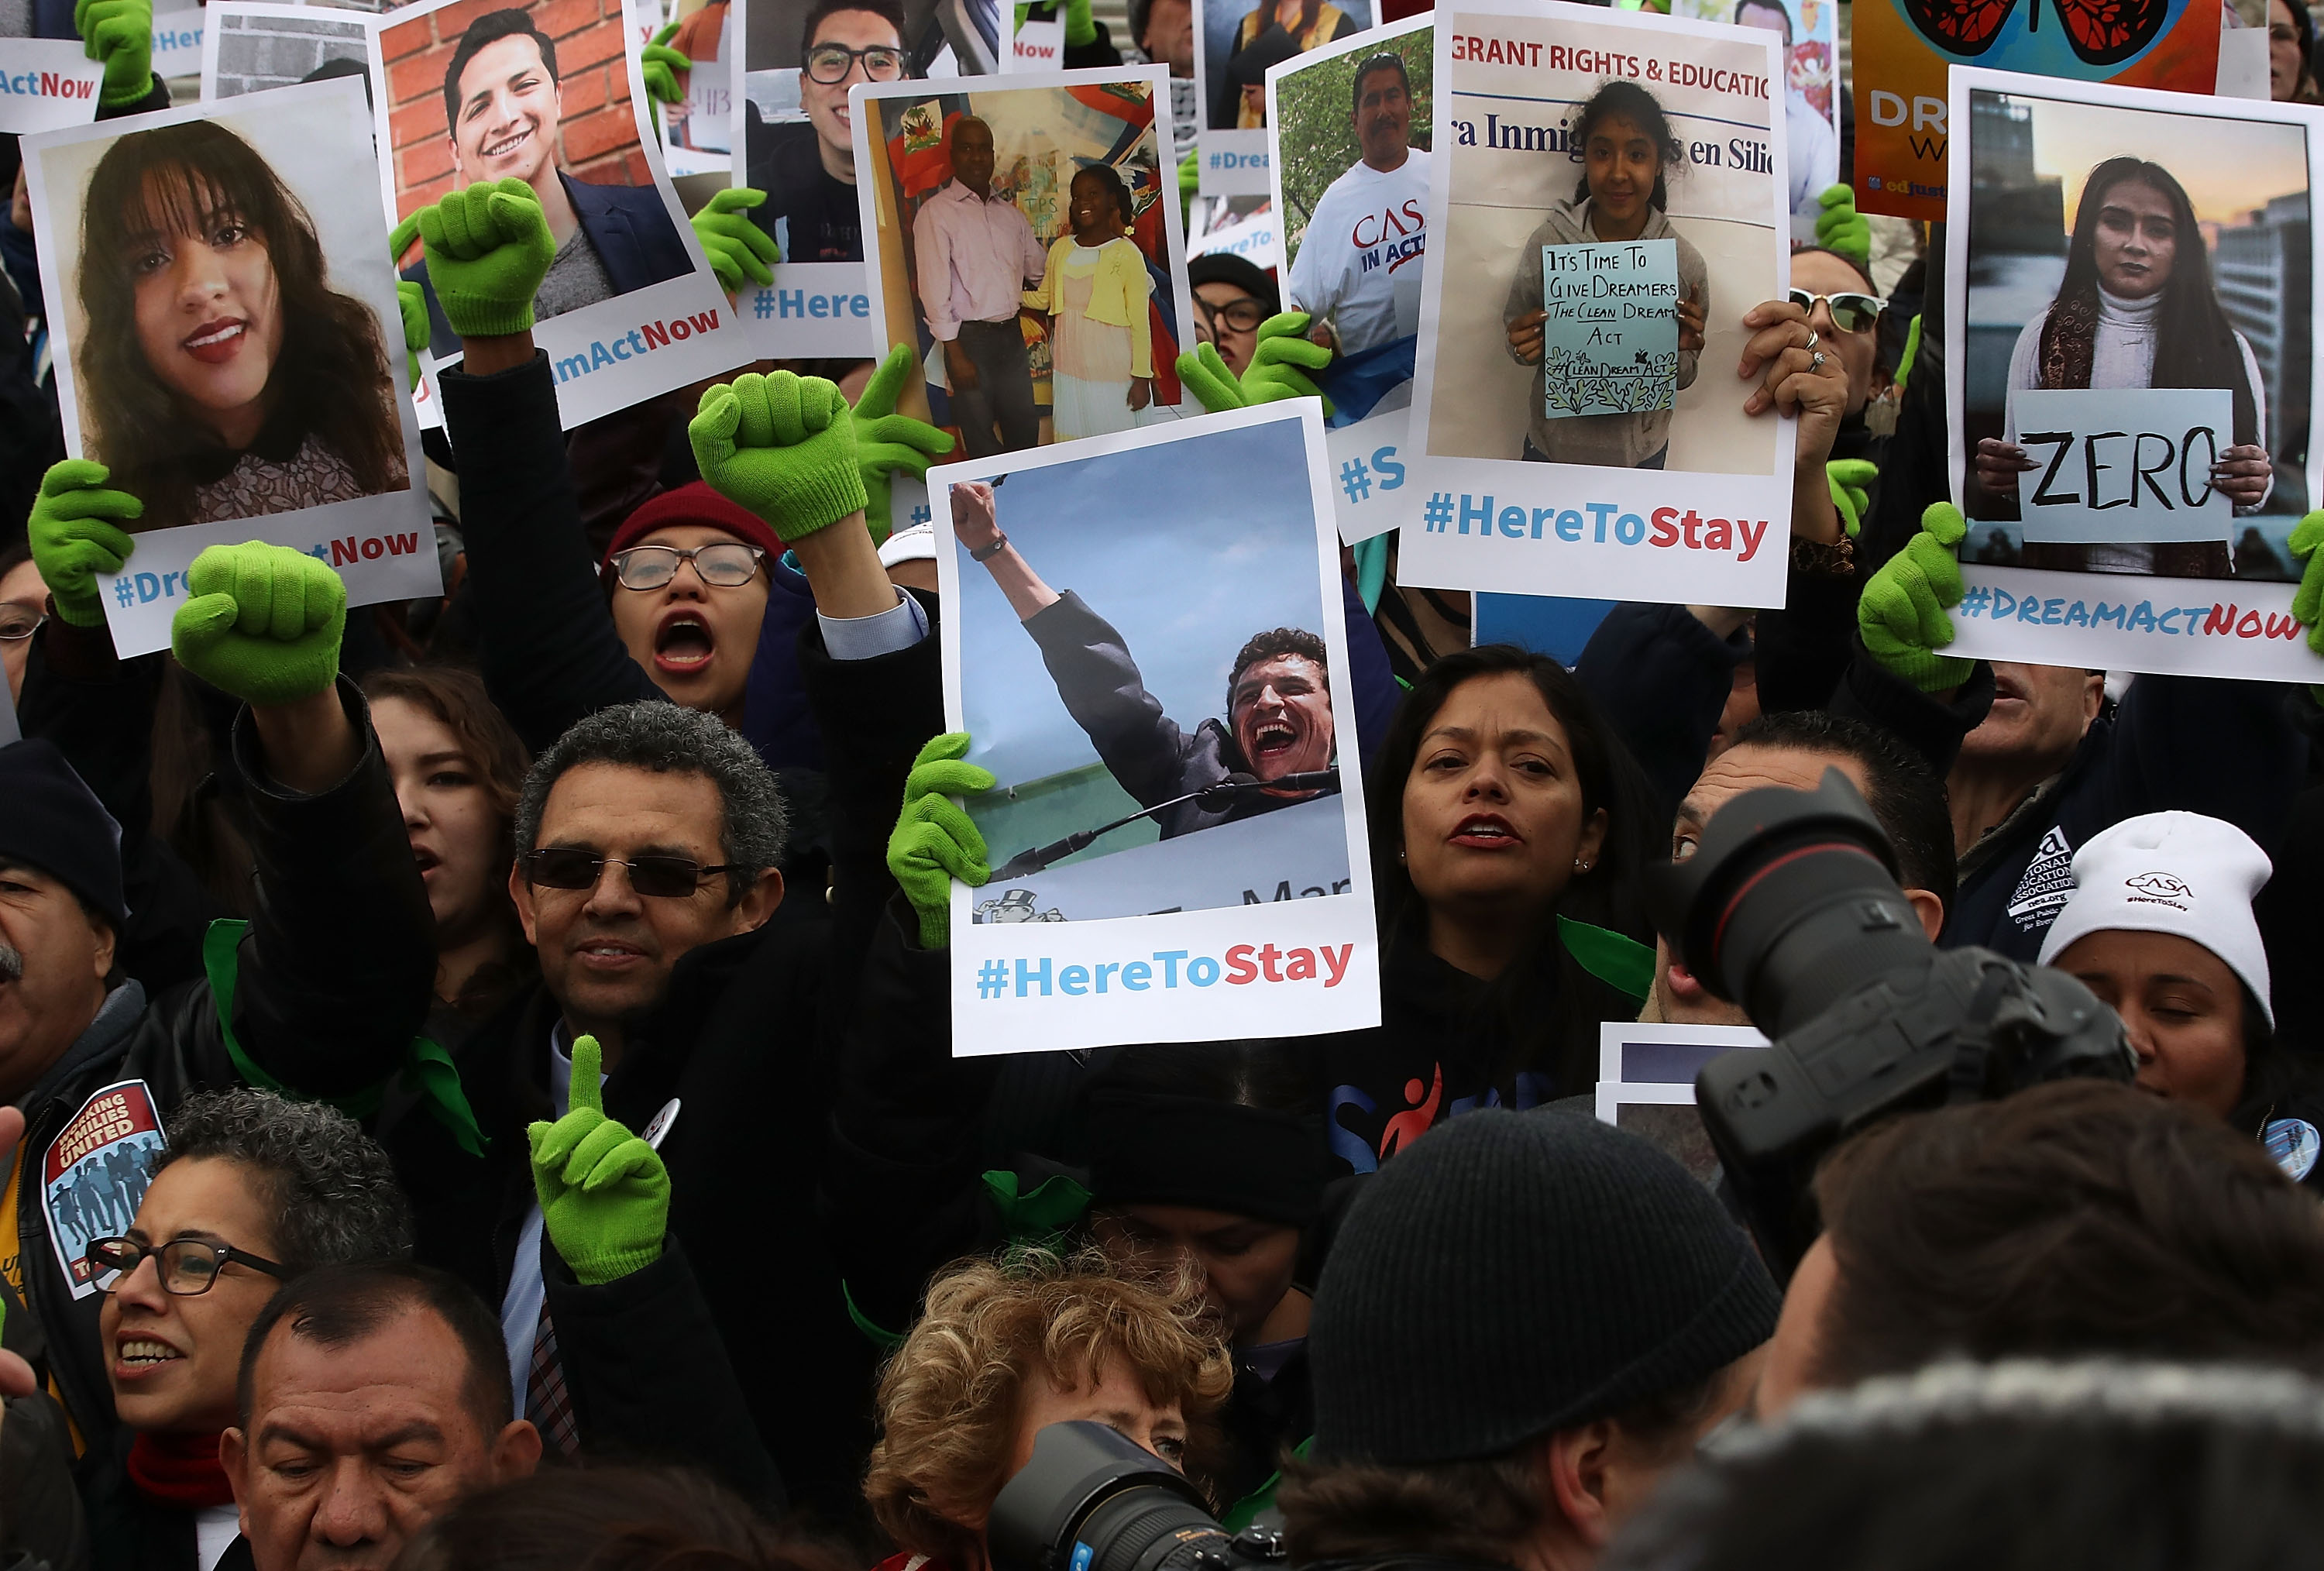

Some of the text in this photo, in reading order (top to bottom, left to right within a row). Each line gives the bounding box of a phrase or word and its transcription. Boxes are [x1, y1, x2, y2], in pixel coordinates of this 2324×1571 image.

[1550, 45, 1639, 78] RIGHTS
[1646, 58, 1662, 81] &
[1690, 139, 1721, 166] en
[1352, 199, 1426, 249] CAS
[1361, 249, 1380, 273] IN
[1579, 249, 1619, 271] TIME
[1624, 246, 1646, 270] TO
[1550, 275, 1677, 298] GIVE DREAMERS
[754, 289, 870, 319] #Here
[1549, 301, 1676, 319] THE CLEAN DREAM
[553, 309, 720, 386] mActNow
[1587, 327, 1622, 345] ACT
[2020, 426, 2216, 510] ZERO
[1423, 492, 1769, 562] #HereToStay
[2125, 878, 2195, 899] CASA
[2126, 896, 2188, 912] #HereToStay
[976, 942, 1354, 999] #HereToStay
[59, 1093, 125, 1146] WORKING
[59, 1105, 130, 1157] FAMILIES
[59, 1119, 135, 1169] UNITED
